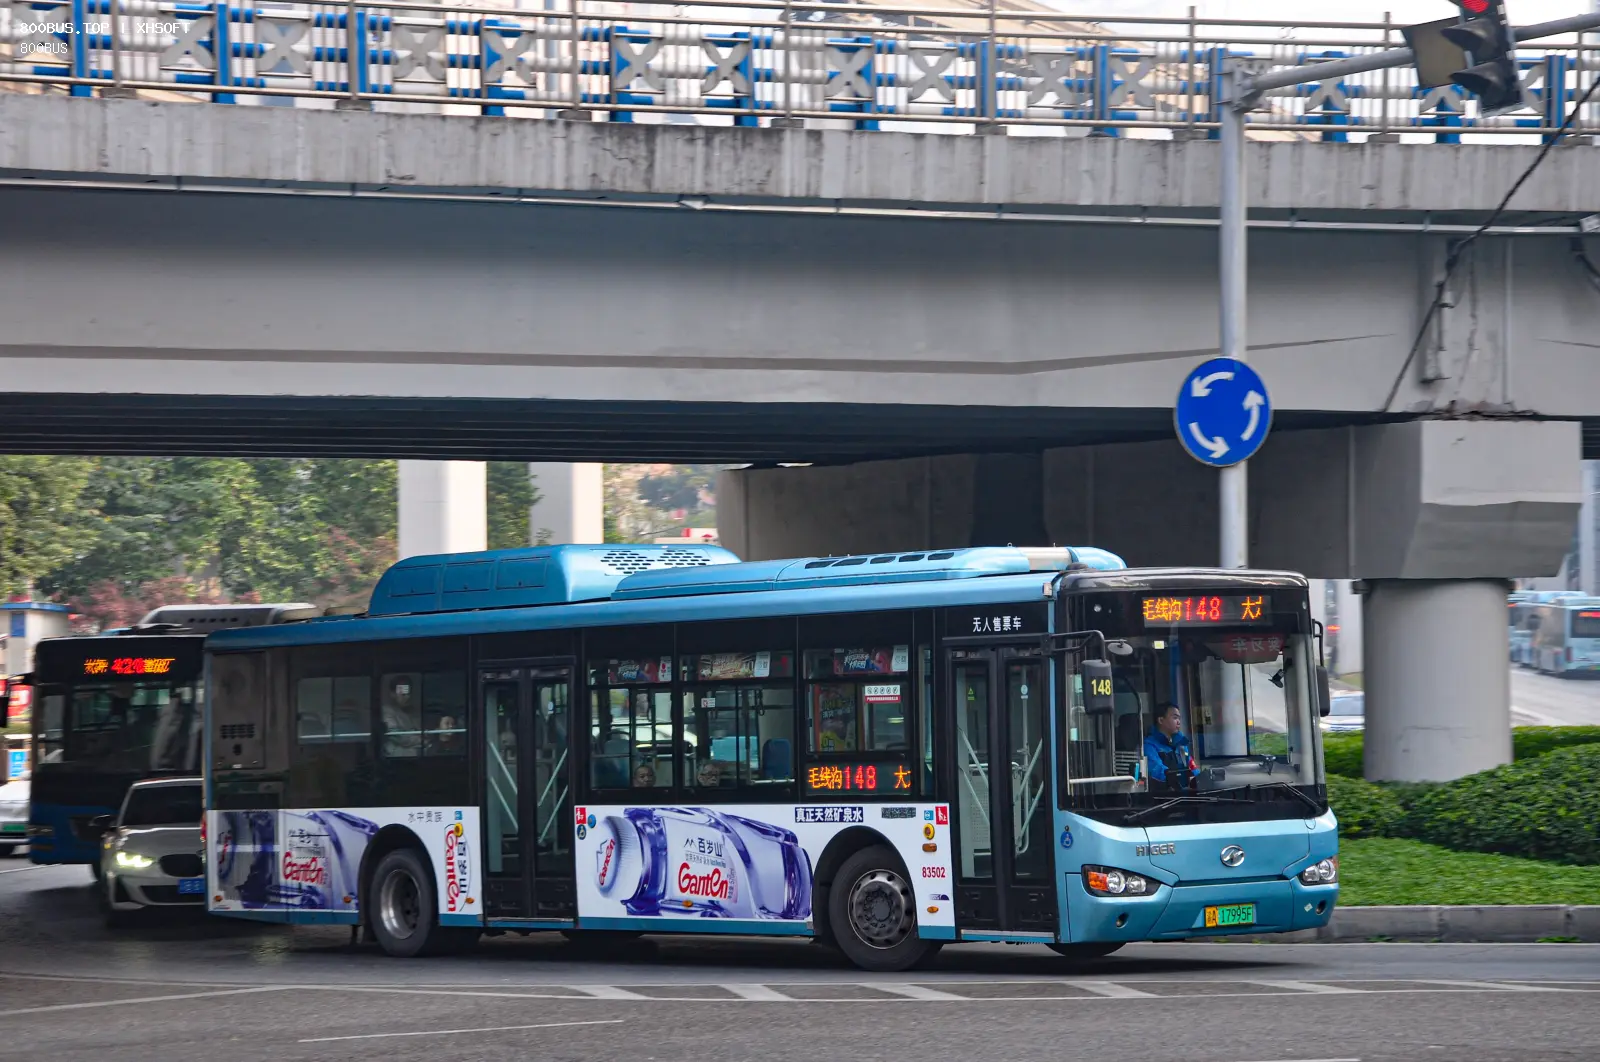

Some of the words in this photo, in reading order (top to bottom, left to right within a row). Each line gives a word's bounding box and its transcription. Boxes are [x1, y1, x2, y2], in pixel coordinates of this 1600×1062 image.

[1143, 598, 1182, 621] 毛线沟
[1185, 597, 1221, 621] 148
[972, 616, 1022, 633] 无人售票车
[1091, 679, 1111, 696] 148
[808, 766, 842, 790] 毛线沟
[844, 766, 877, 790] 148
[894, 765, 911, 789] 大
[796, 807, 863, 823] 真正天然矿泉水
[698, 838, 723, 857] 百岁山
[1136, 843, 1176, 857] HIGER
[445, 829, 461, 912] Ganten
[922, 867, 946, 878] 83502
[678, 862, 729, 899] Ganten
